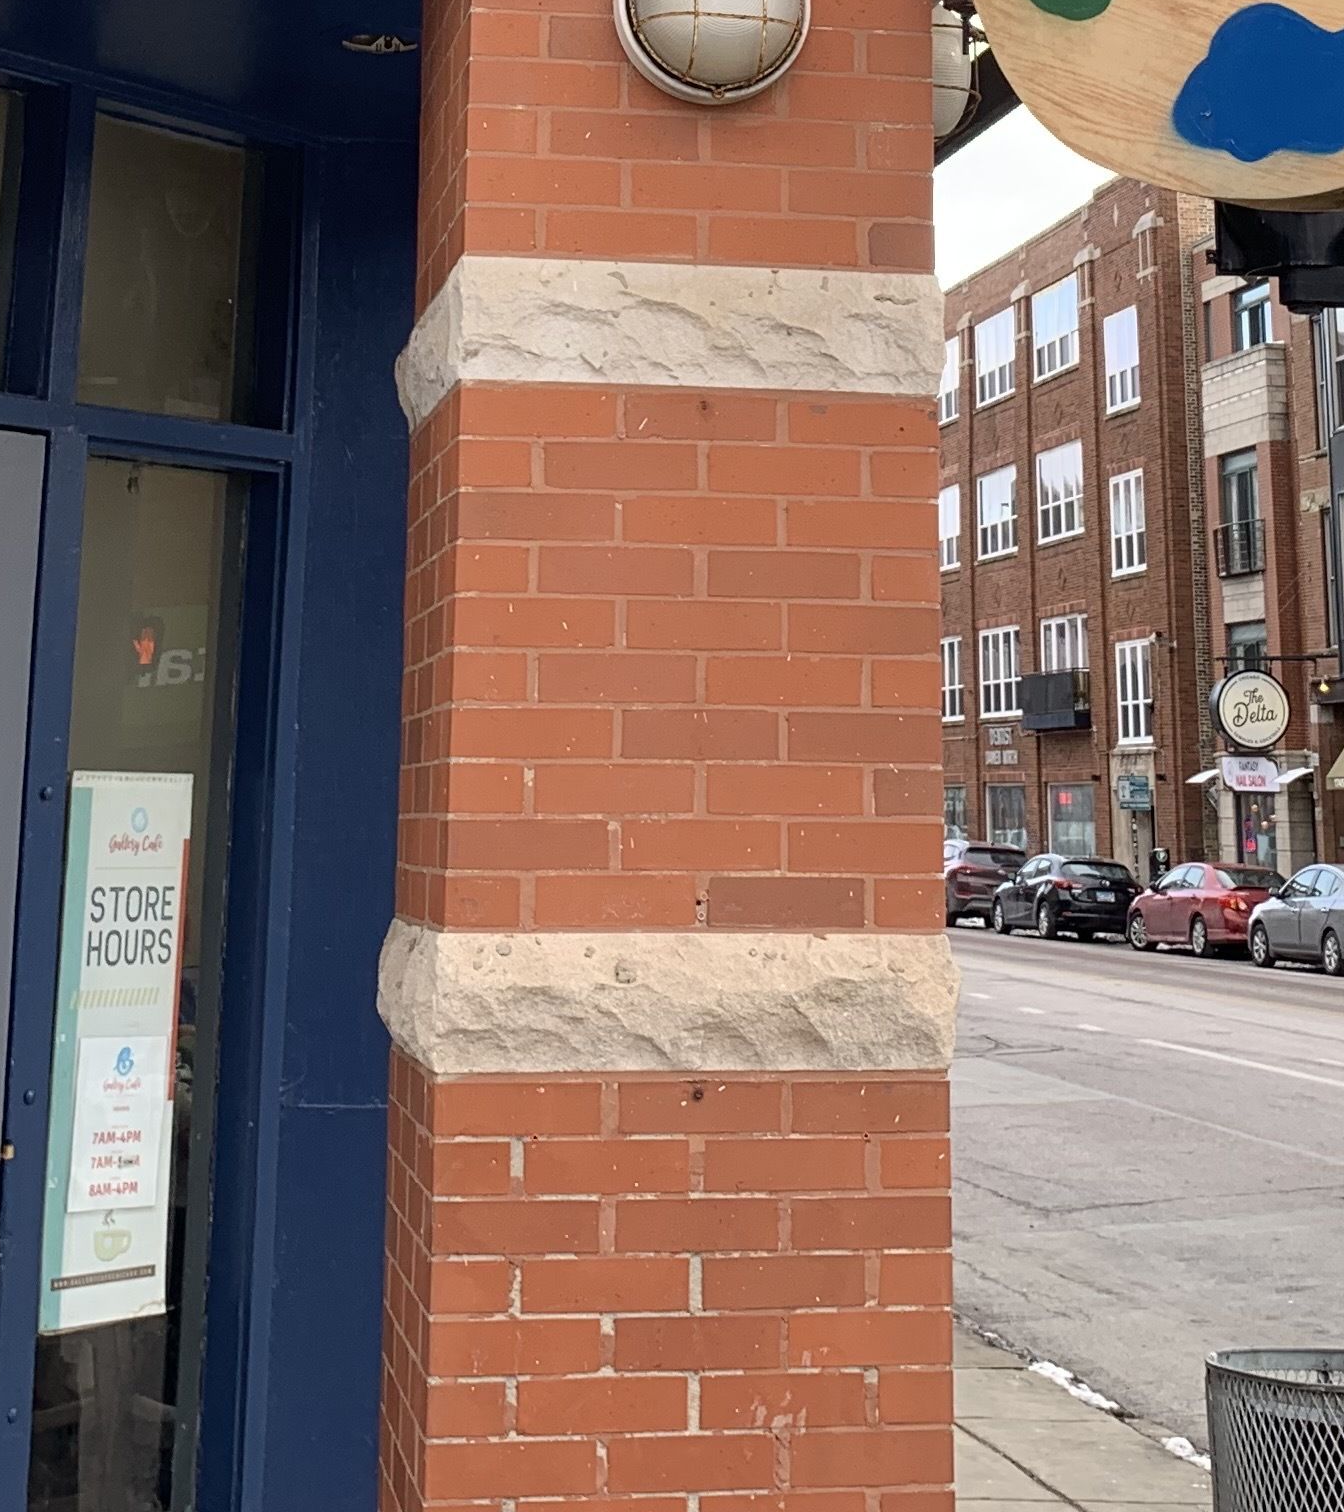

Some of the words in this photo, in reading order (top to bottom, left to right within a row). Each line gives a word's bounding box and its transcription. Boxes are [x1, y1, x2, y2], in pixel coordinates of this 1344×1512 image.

[1244, 688, 1264, 705] The
[1233, 702, 1278, 727] Delta
[109, 833, 140, 856] Gallery
[90, 886, 175, 923] STORE
[86, 928, 173, 967] HOURS
